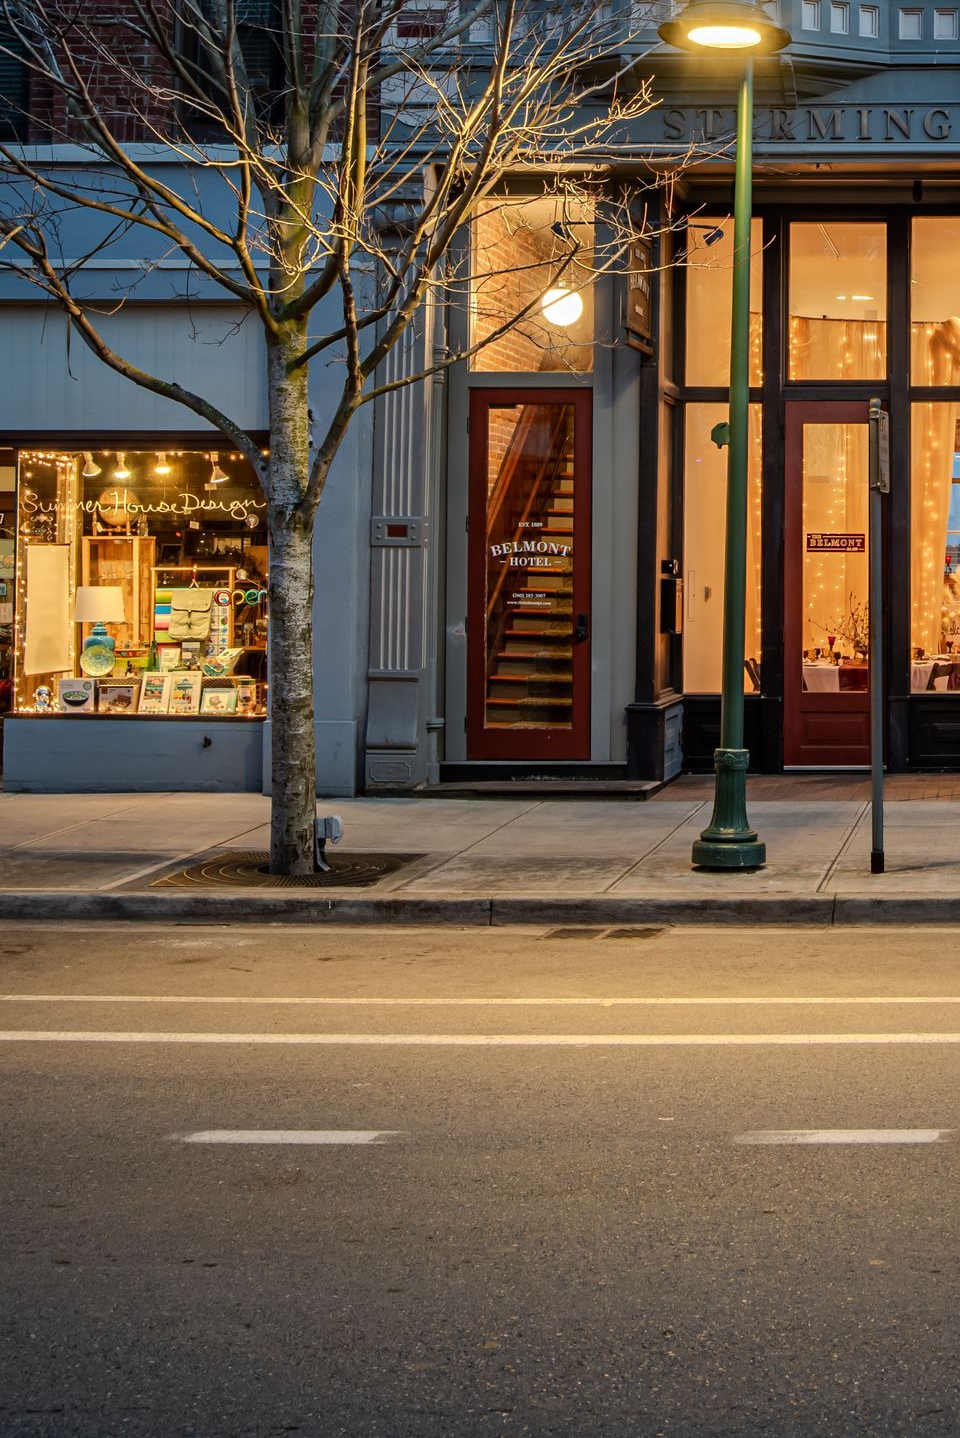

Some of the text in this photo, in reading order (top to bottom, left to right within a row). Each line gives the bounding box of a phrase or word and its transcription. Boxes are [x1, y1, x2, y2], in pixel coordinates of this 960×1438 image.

[109, 489, 179, 516] House
[178, 493, 266, 519] Design
[490, 541, 571, 557] BELMONT
[809, 538, 863, 547] BELMONT
[510, 556, 552, 567] HOTEL
